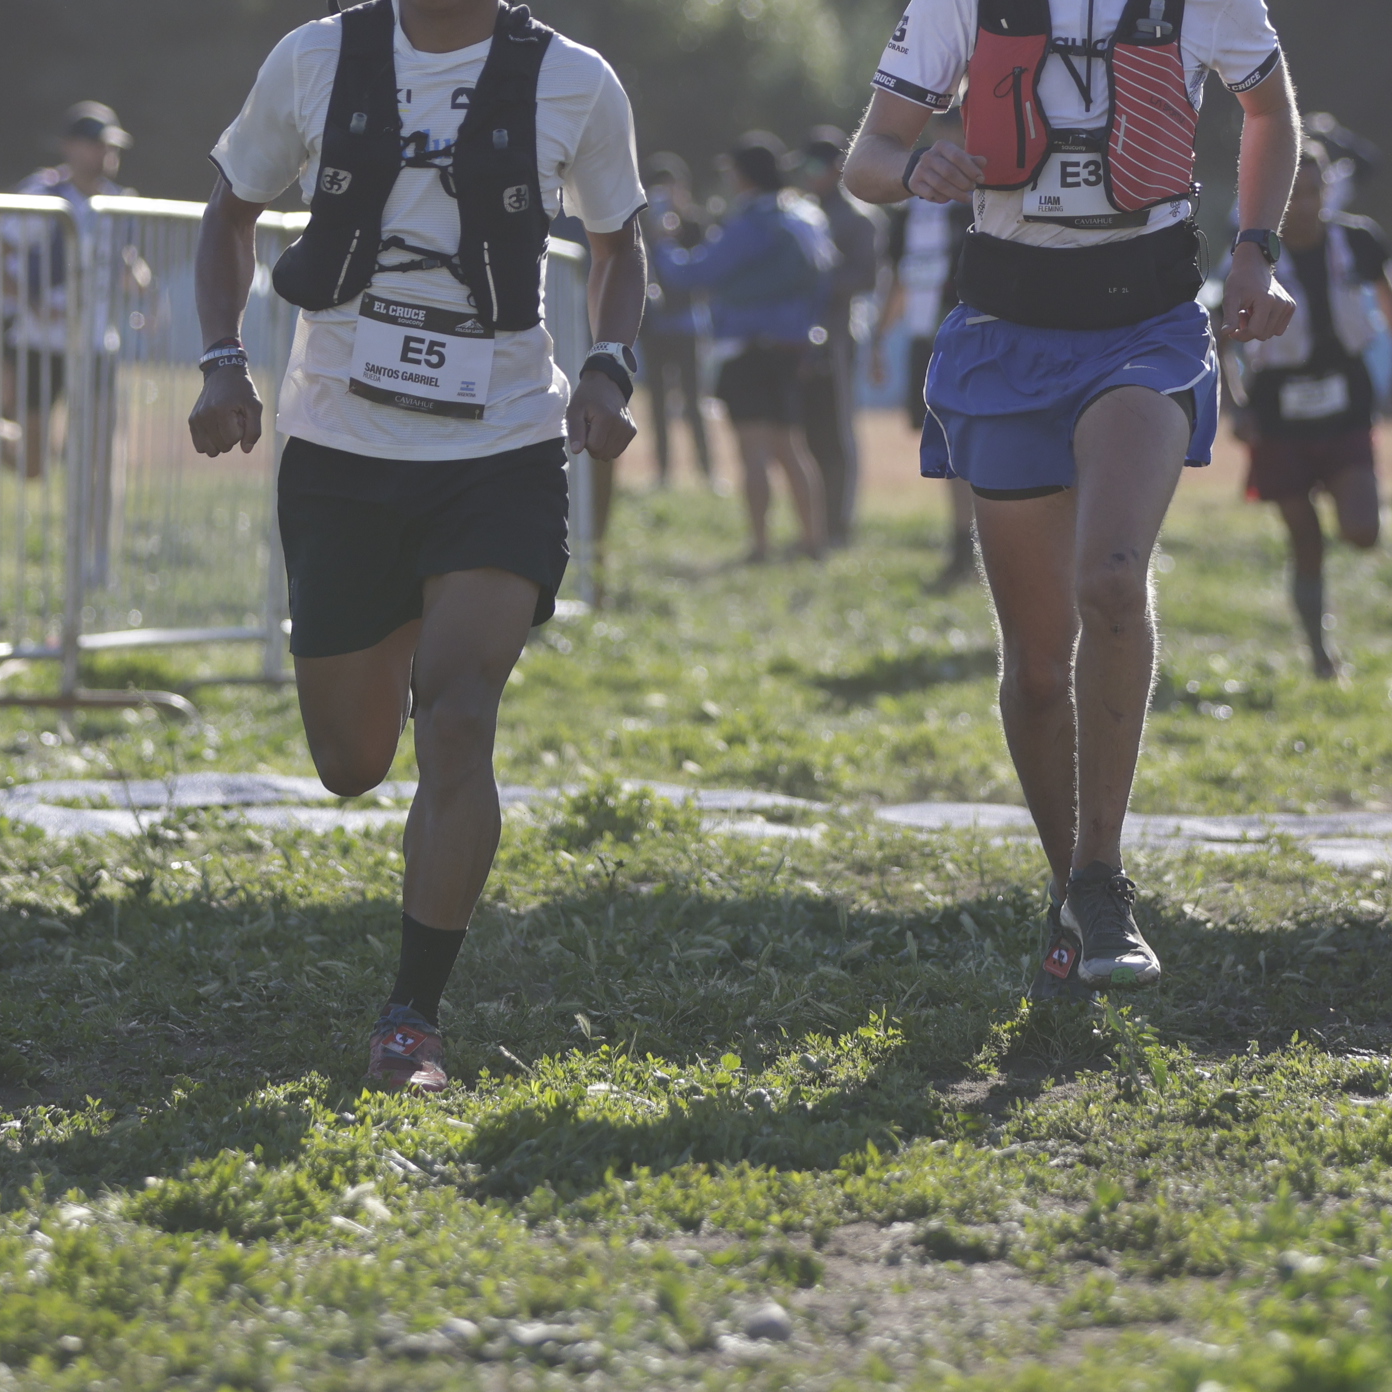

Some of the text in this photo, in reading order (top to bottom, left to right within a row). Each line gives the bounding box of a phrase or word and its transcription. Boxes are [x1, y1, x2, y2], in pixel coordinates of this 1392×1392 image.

[1231, 70, 1261, 91] CRUCE
[925, 93, 937, 104] EL
[1060, 159, 1104, 189] E3
[1039, 195, 1061, 206] LIAM
[1037, 205, 1064, 213] FLEMING
[1074, 217, 1113, 225] CAVIAHUE
[373, 300, 427, 321] EL CRUCE
[397, 317, 425, 327] saucony
[399, 334, 447, 370] E5
[362, 371, 382, 383] RUEDA
[364, 361, 441, 388] SANTOS GABRIEL
[394, 395, 435, 409] CAVIAHUE
